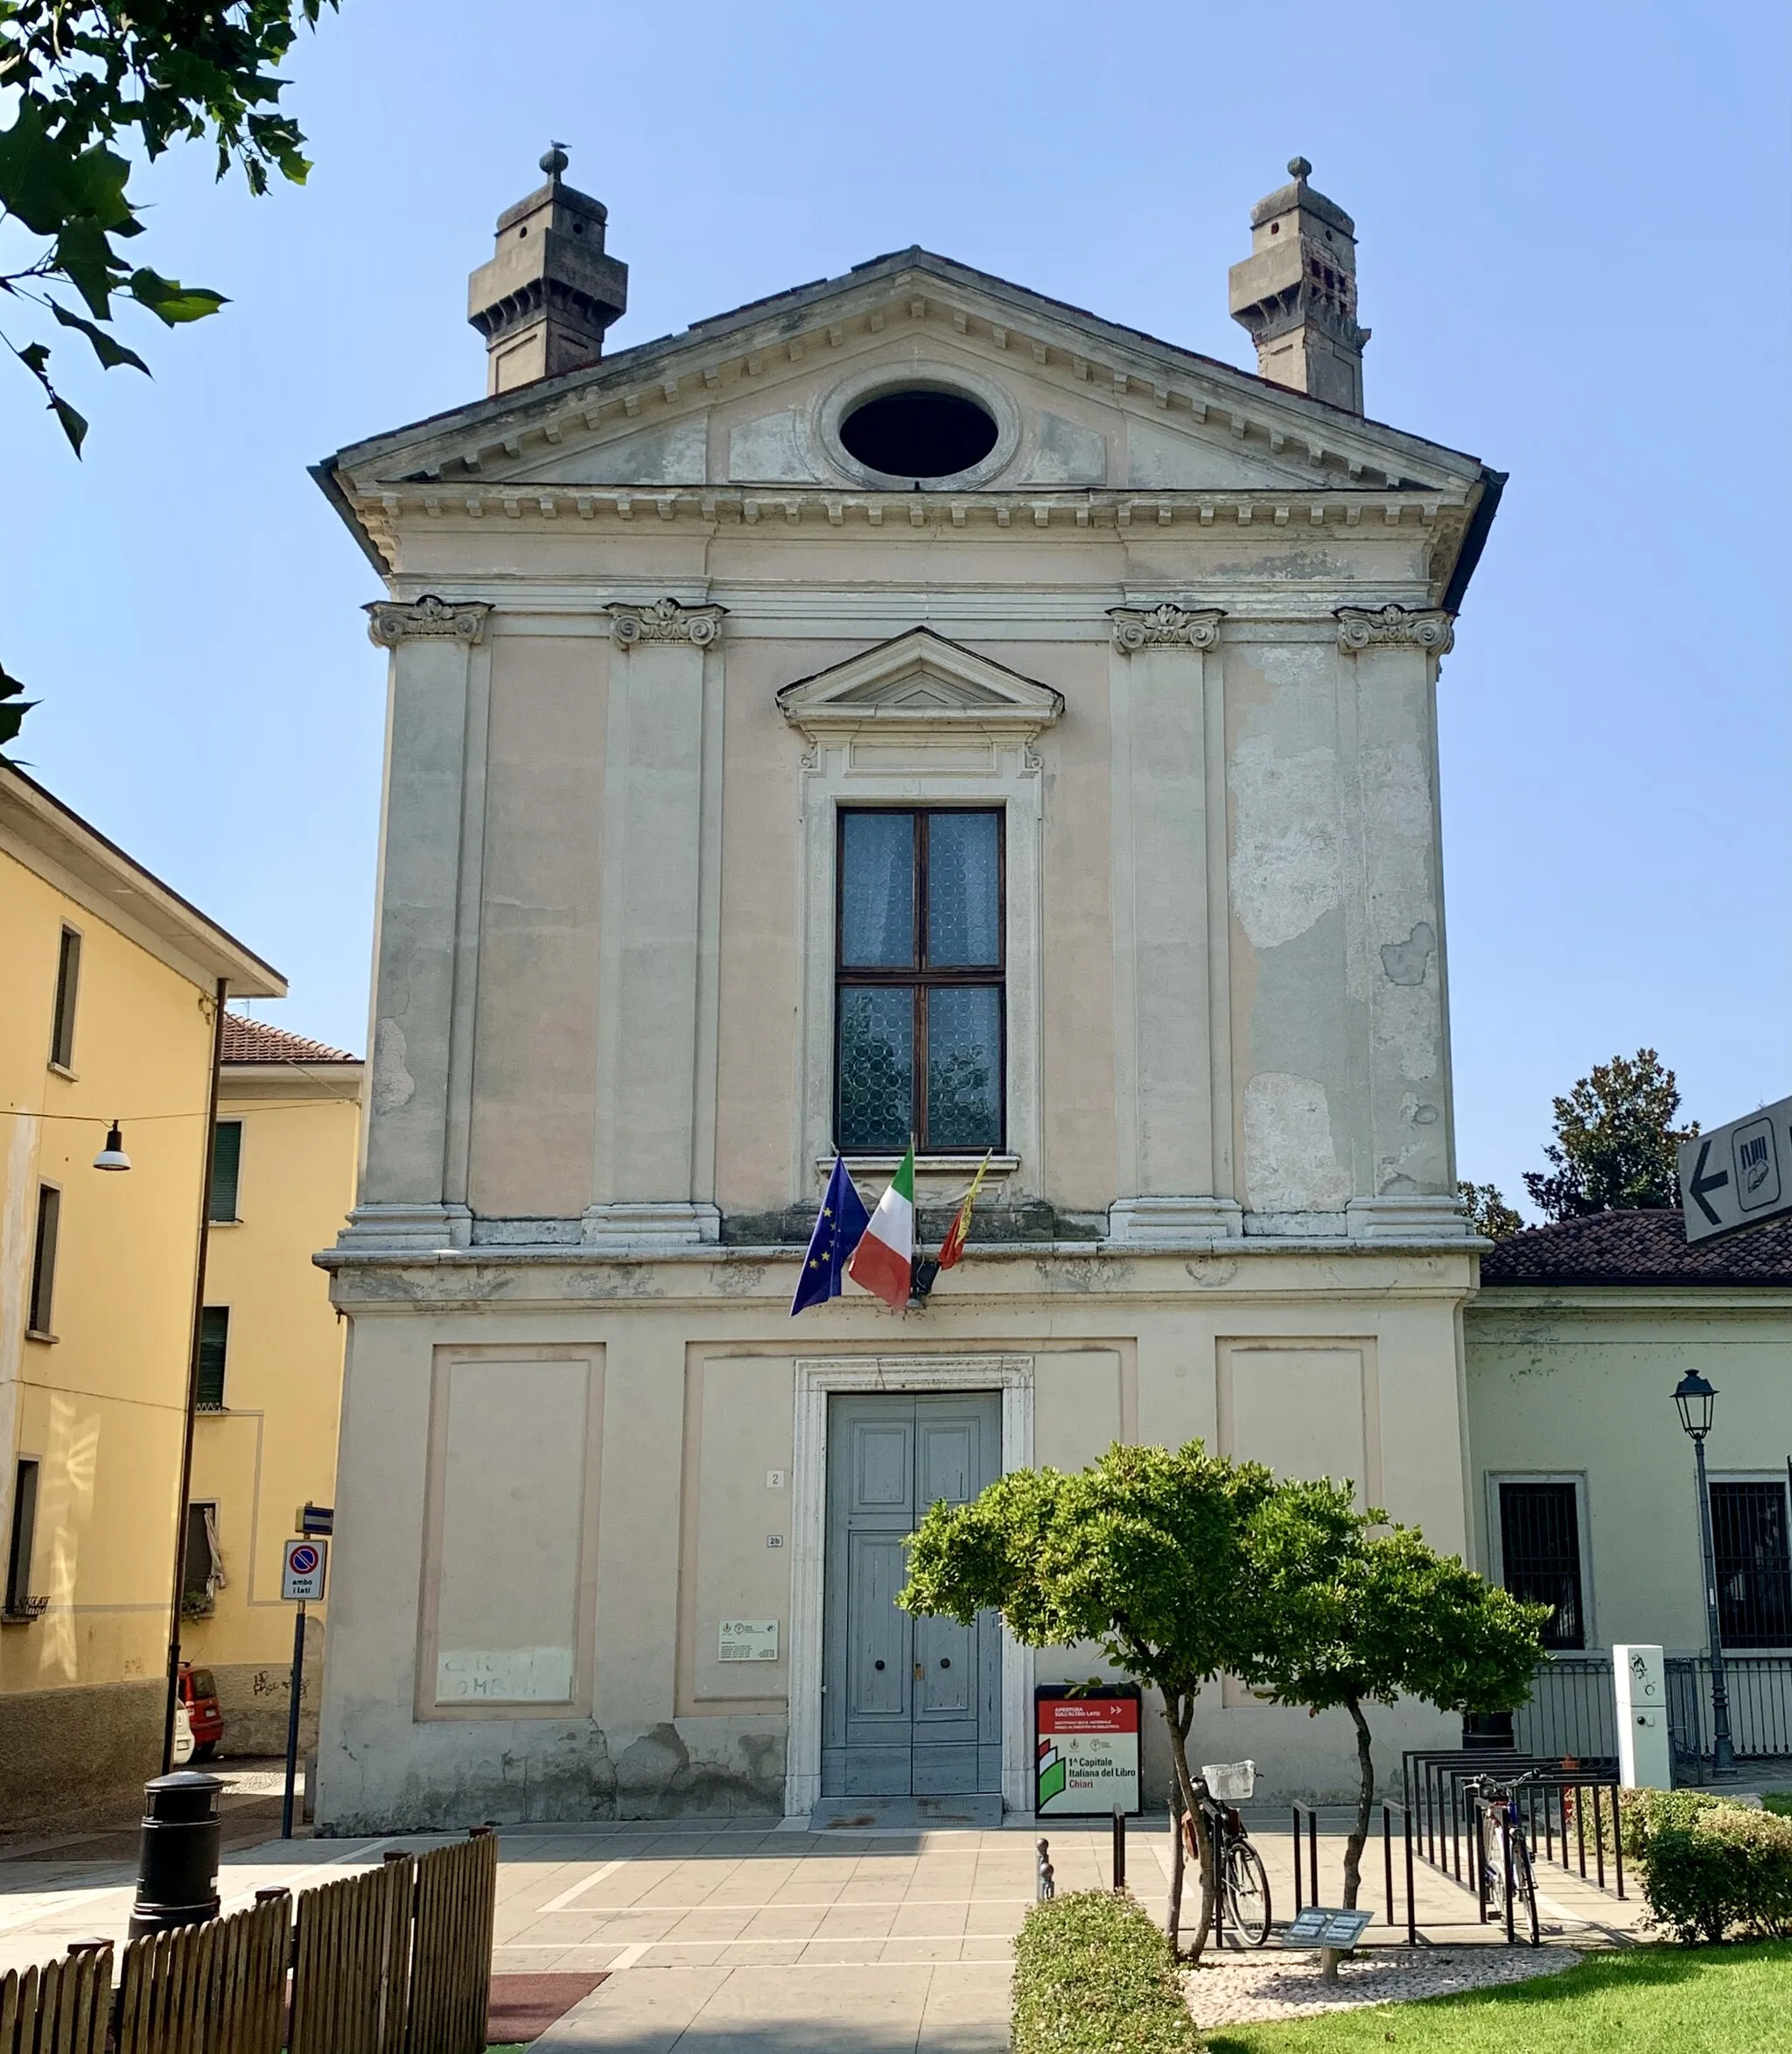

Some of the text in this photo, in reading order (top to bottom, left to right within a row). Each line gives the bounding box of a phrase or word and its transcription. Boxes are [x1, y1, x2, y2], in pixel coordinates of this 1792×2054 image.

[772, 1474, 779, 1485] 2
[1079, 1757, 1112, 1768] Capitale
[1069, 1768, 1136, 1777] Italiana del Libro
[1069, 1779, 1093, 1789] Chiari
